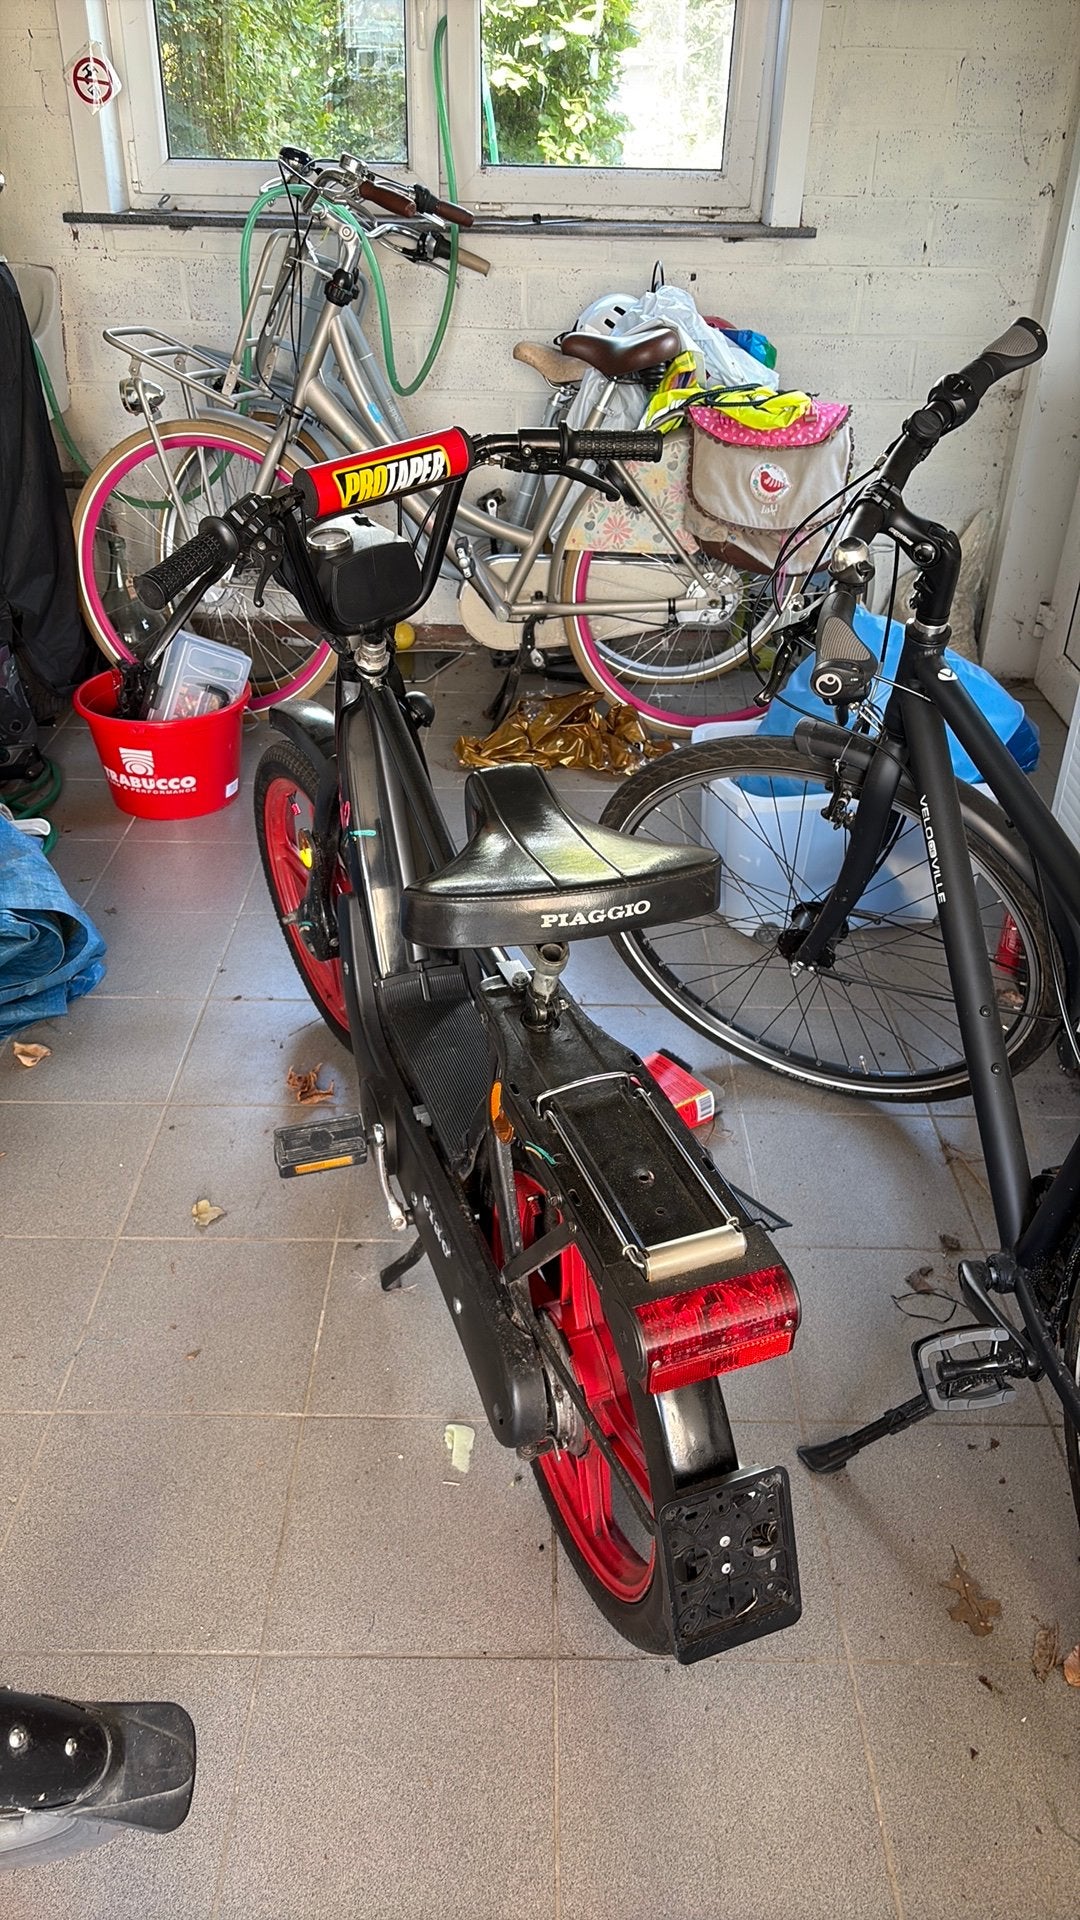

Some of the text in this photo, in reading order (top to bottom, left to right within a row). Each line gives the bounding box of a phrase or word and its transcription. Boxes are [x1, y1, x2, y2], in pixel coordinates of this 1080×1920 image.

[344, 451, 446, 505] PROTAPER
[103, 765, 197, 790] TRABUCCO
[540, 900, 651, 928] PIAGGIO
